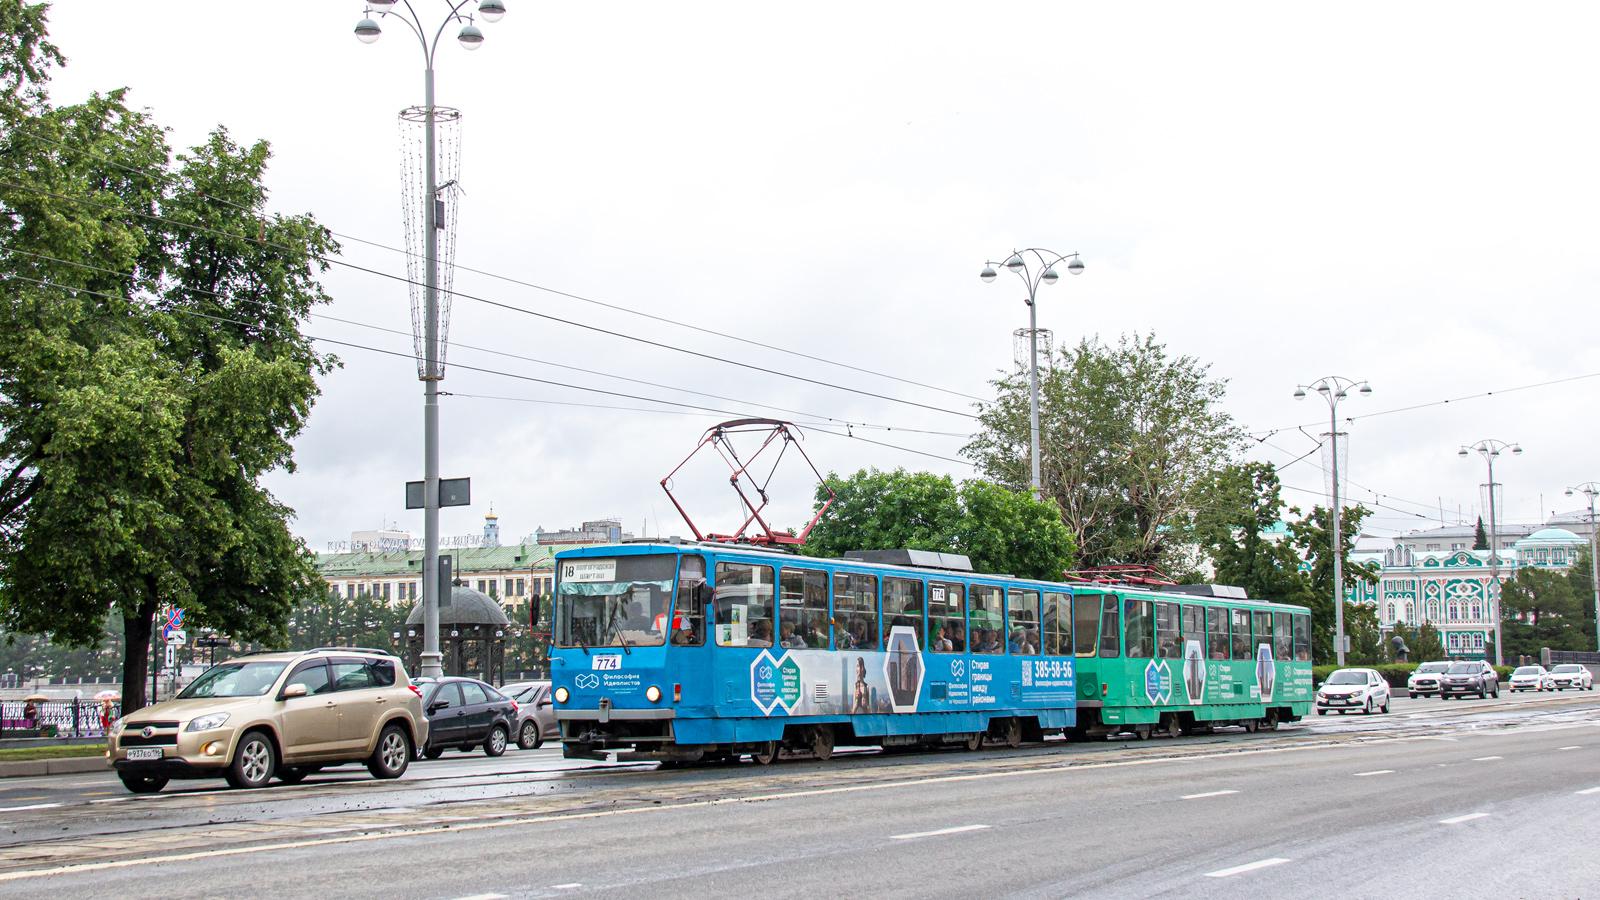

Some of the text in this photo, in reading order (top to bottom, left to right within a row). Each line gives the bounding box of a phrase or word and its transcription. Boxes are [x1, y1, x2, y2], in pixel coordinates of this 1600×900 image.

[565, 565, 575, 578] 18
[932, 589, 944, 600] 774
[597, 658, 617, 670] 774
[972, 660, 989, 672] Стирая
[1034, 661, 1072, 678] 385-58-56
[972, 674, 992, 683] границы
[972, 684, 988, 694] между
[972, 694, 996, 706] районами
